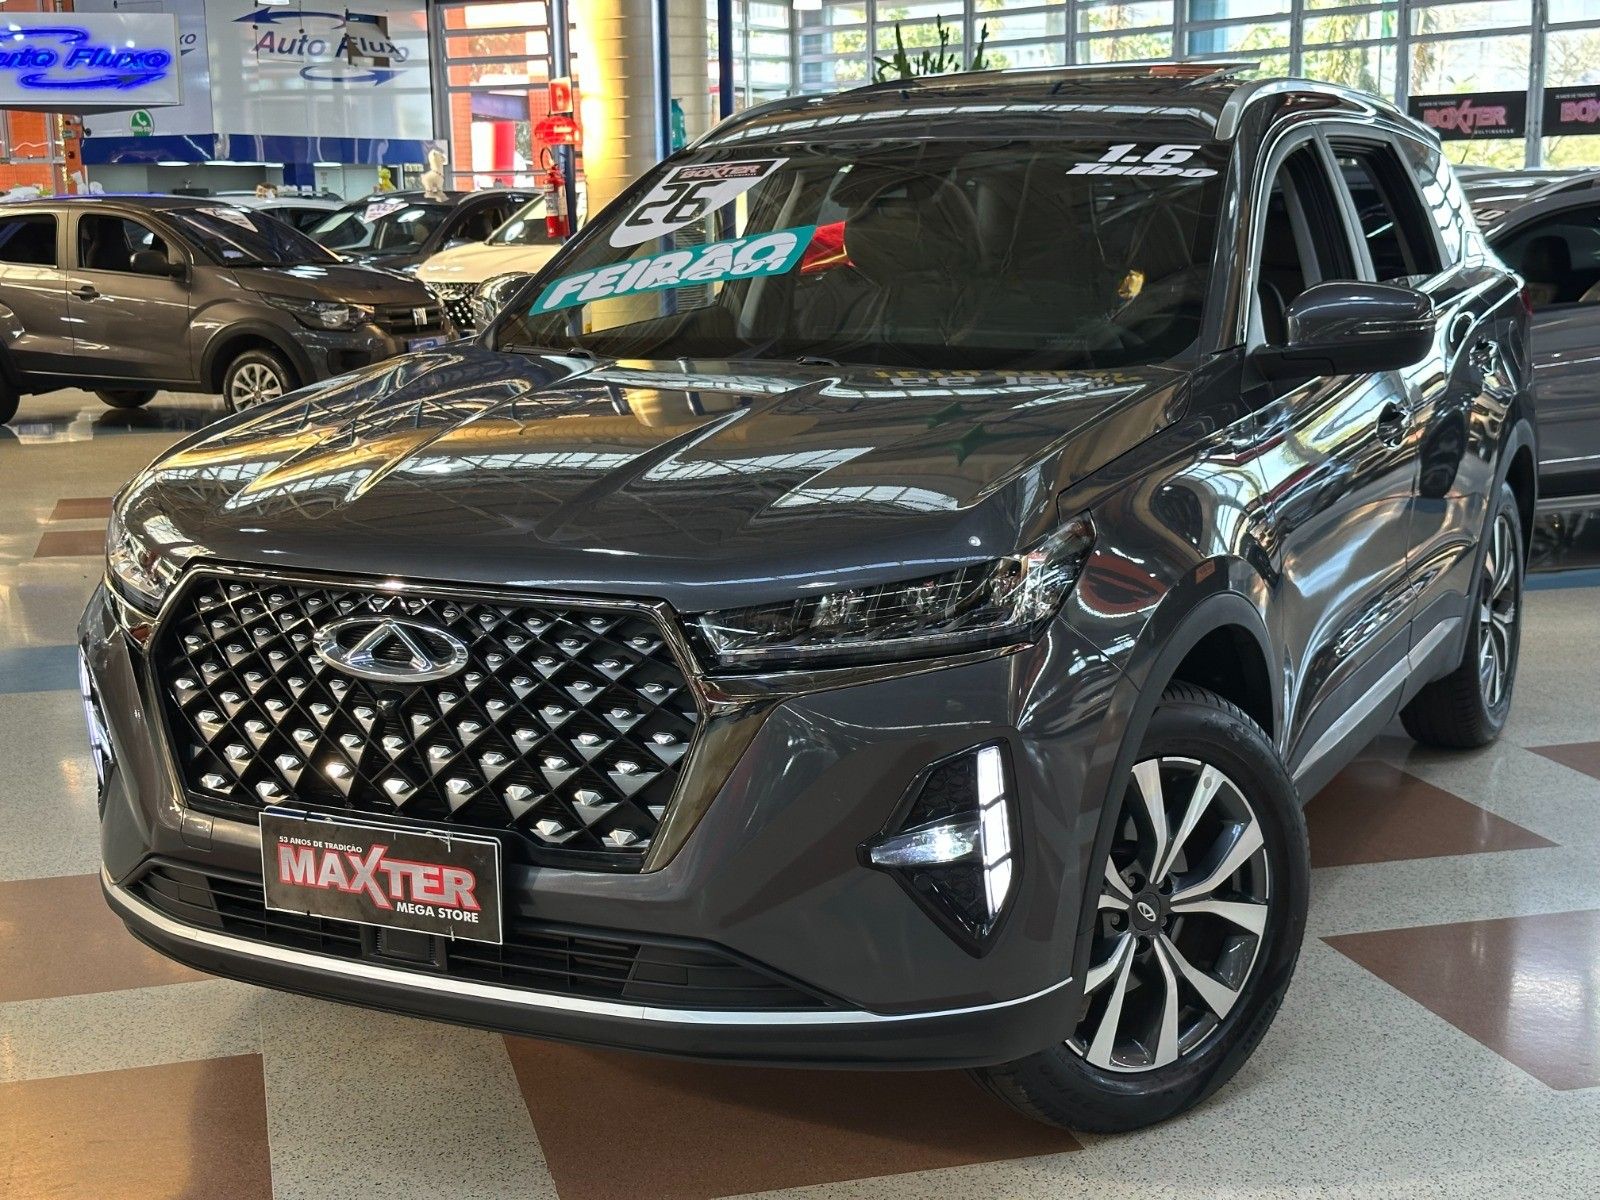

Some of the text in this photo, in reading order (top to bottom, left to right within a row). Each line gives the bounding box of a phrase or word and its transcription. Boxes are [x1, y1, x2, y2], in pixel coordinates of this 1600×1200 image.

[65, 46, 170, 69] Fluxo
[252, 31, 409, 62] Auto Fluxo
[1423, 99, 1506, 134] BOXTER
[1098, 143, 1201, 164] 1.6
[679, 164, 760, 179] BOXTER
[1066, 163, 1218, 178] Turbo
[625, 180, 728, 227] 26
[543, 232, 798, 310] FEIRÃO
[279, 835, 363, 854] 53 ANOS DE TRADIÇÃO
[277, 843, 481, 911] MAXTER
[396, 901, 480, 924] MEGA STORE
